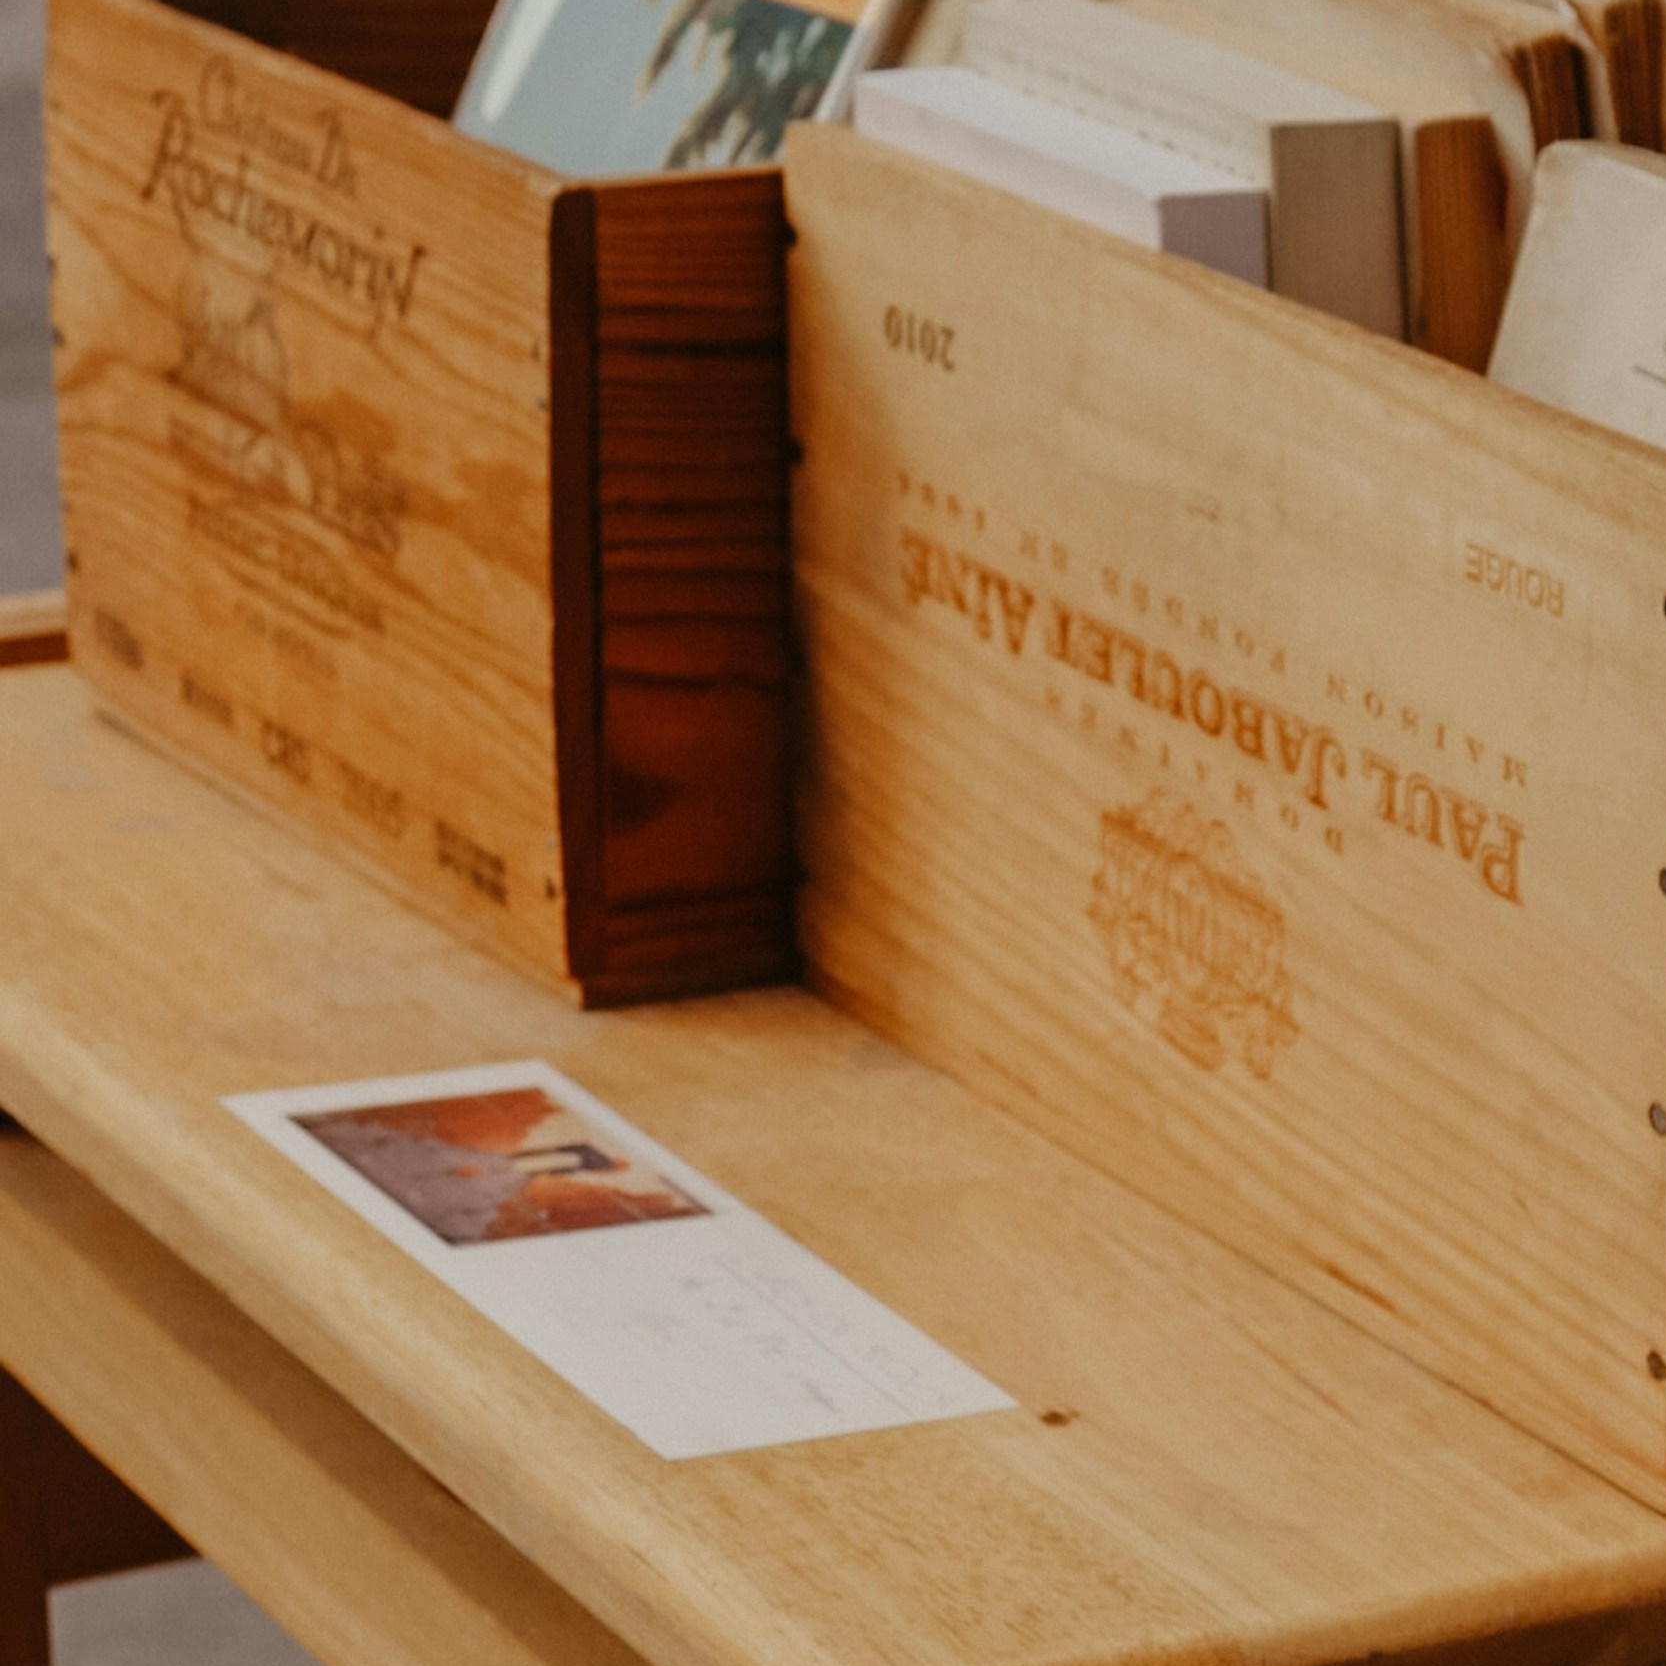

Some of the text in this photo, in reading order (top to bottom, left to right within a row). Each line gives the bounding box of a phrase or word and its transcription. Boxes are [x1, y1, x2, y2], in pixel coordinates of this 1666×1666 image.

[883, 303, 956, 374] 2010
[1465, 540, 1566, 620] ROUGE
[1044, 595, 1348, 813] JABOULET
[1324, 670, 1528, 790] MAISON
[1361, 745, 1525, 909] PAUL
